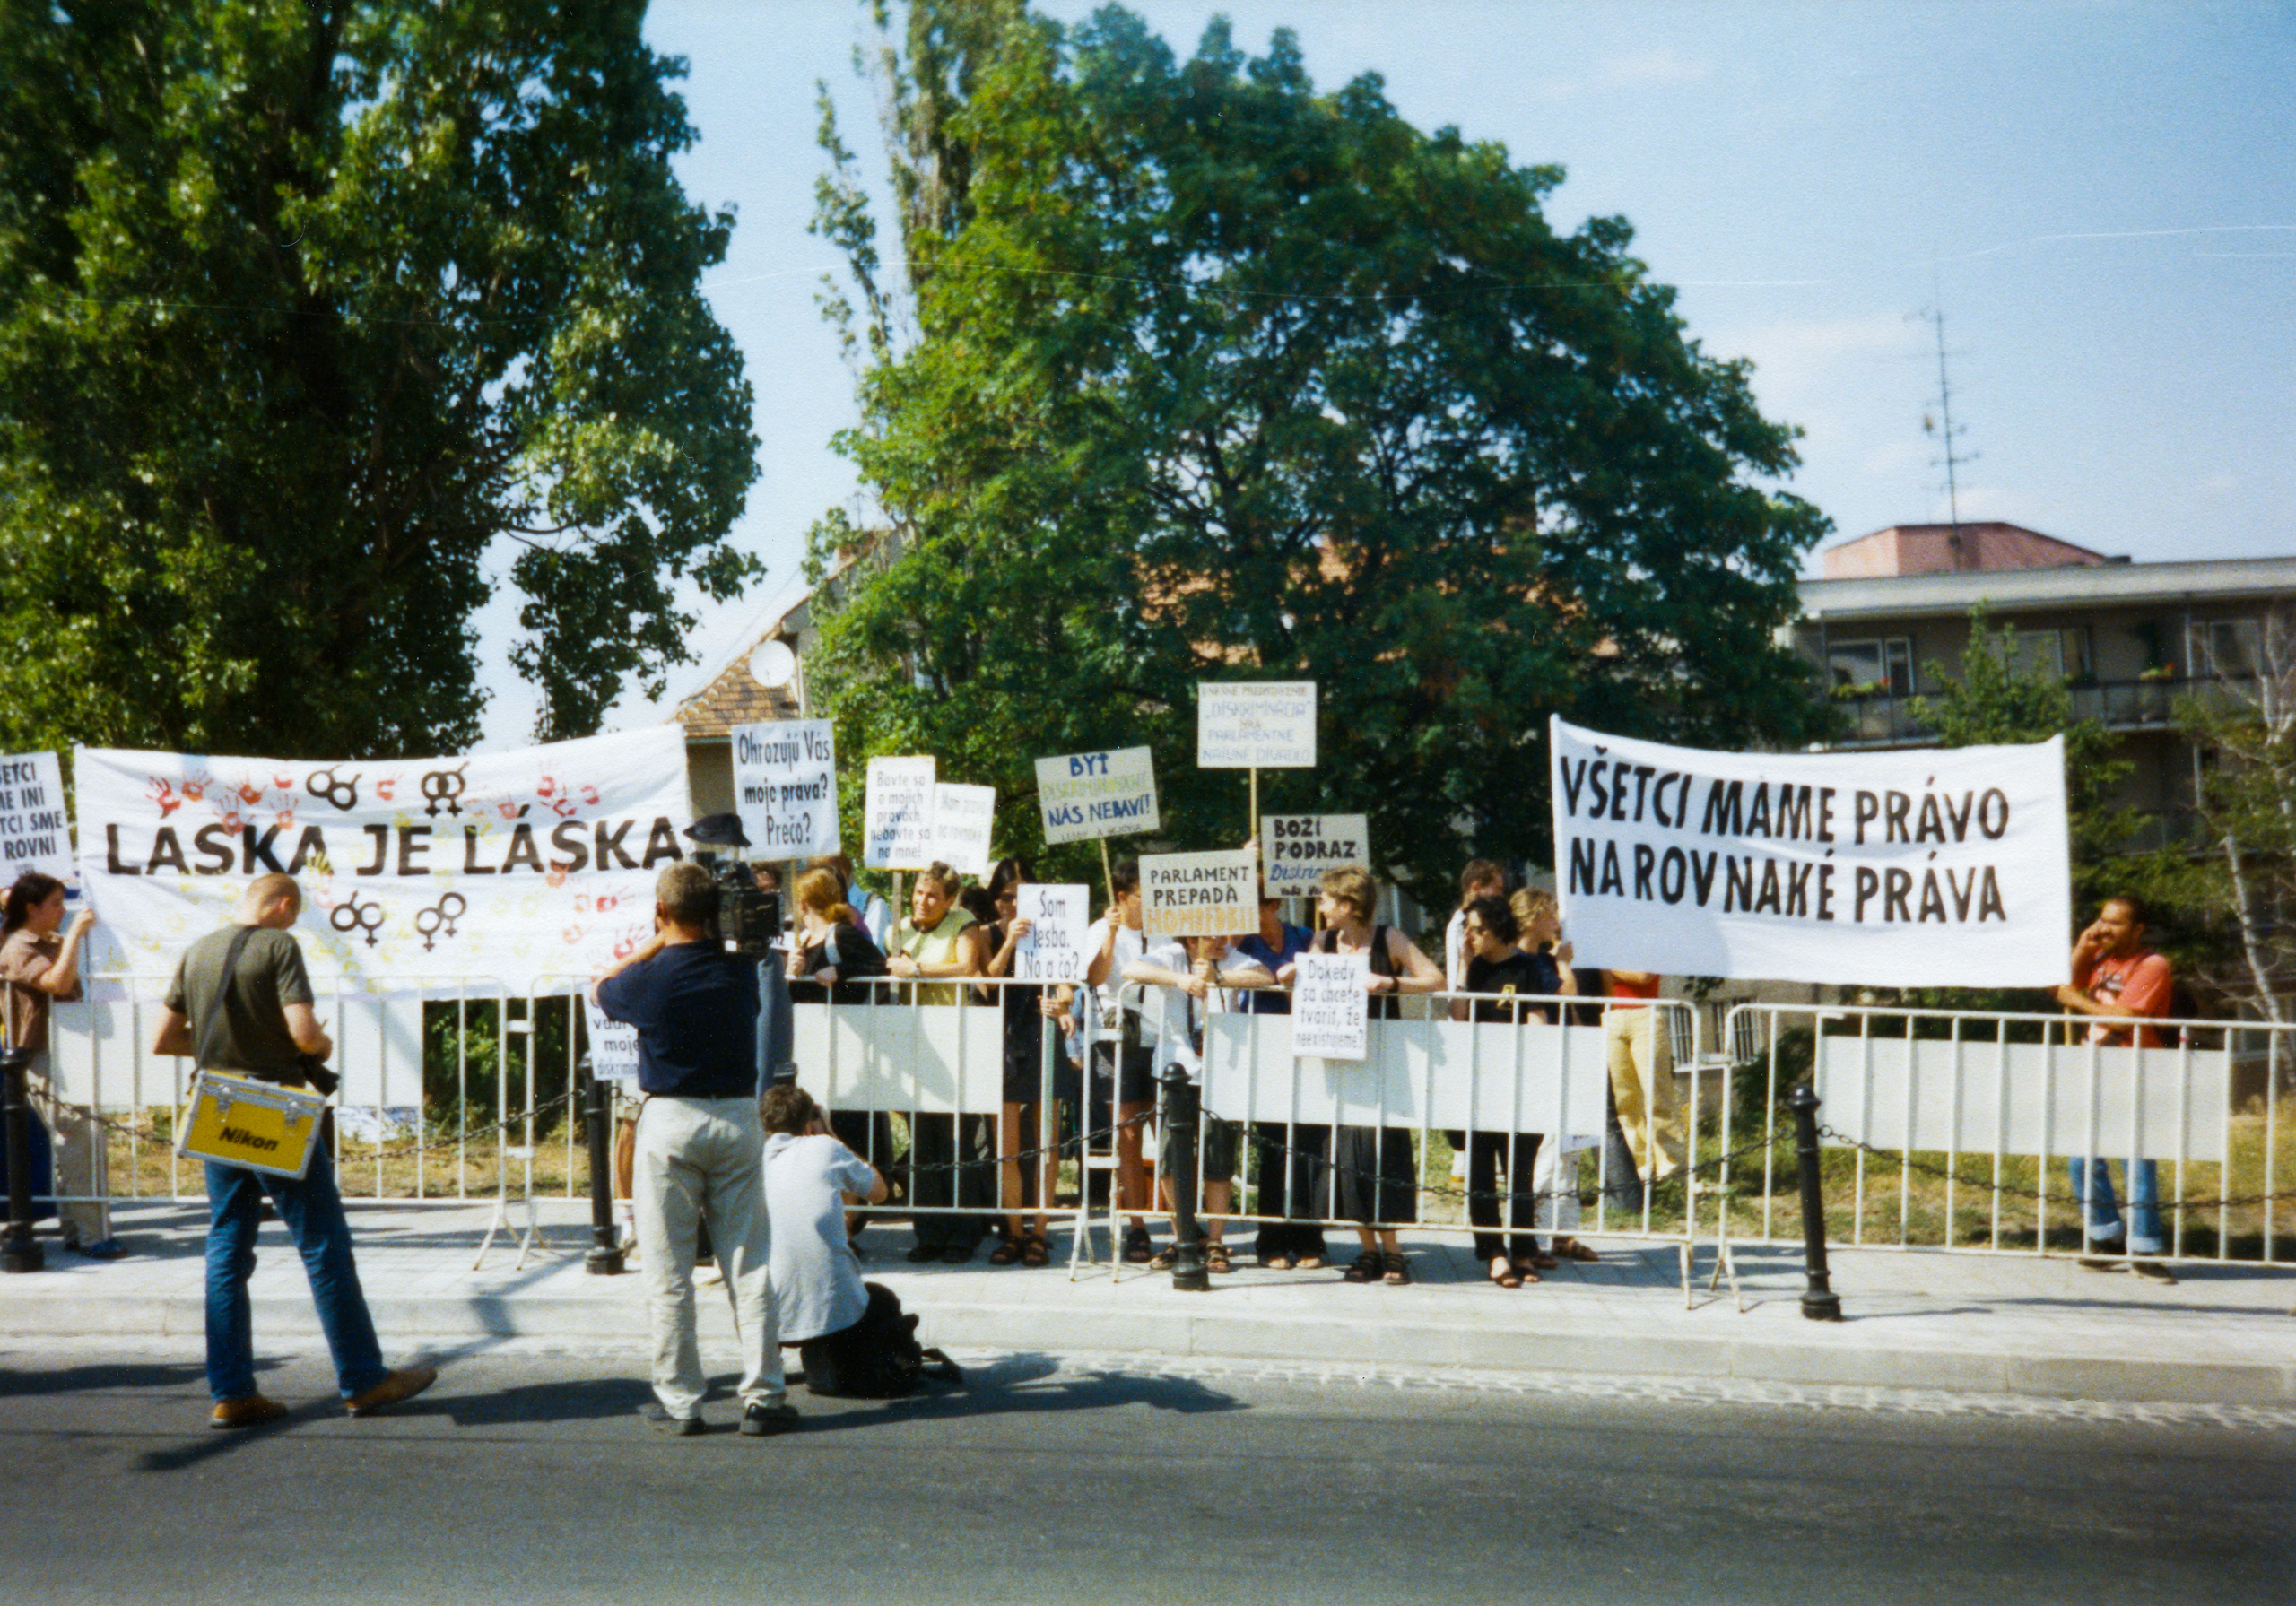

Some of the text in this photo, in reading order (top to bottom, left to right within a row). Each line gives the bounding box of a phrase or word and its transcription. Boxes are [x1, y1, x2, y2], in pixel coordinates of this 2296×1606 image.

[739, 730, 830, 773] Ohrozujú Vás
[0, 761, 36, 786] ETCI
[744, 772, 828, 813] moje práva?
[1560, 744, 1692, 829] VŠETCI
[1855, 775, 2009, 845] PRÁVO
[30, 810, 62, 831] SME
[1048, 793, 1150, 827] NÁS NEBAVÍ!
[356, 823, 433, 877] JE
[464, 803, 683, 875] LÁSKA
[766, 812, 811, 846] Prečo?
[1274, 840, 1356, 860] PODRAZ
[1150, 865, 1249, 884] PARLAMENT
[1570, 837, 2006, 923] NA ROVNAKÉ PRÁVA
[1040, 890, 1065, 918] Som
[1153, 883, 1238, 907] PREPADÁ
[1033, 920, 1070, 948] lesba.
[1024, 951, 1079, 979] No a čo?
[1309, 959, 1356, 991] Dokedy
[1302, 987, 1316, 1003] sa
[1347, 1005, 1360, 1026] že
[219, 1126, 279, 1152] Nikon
